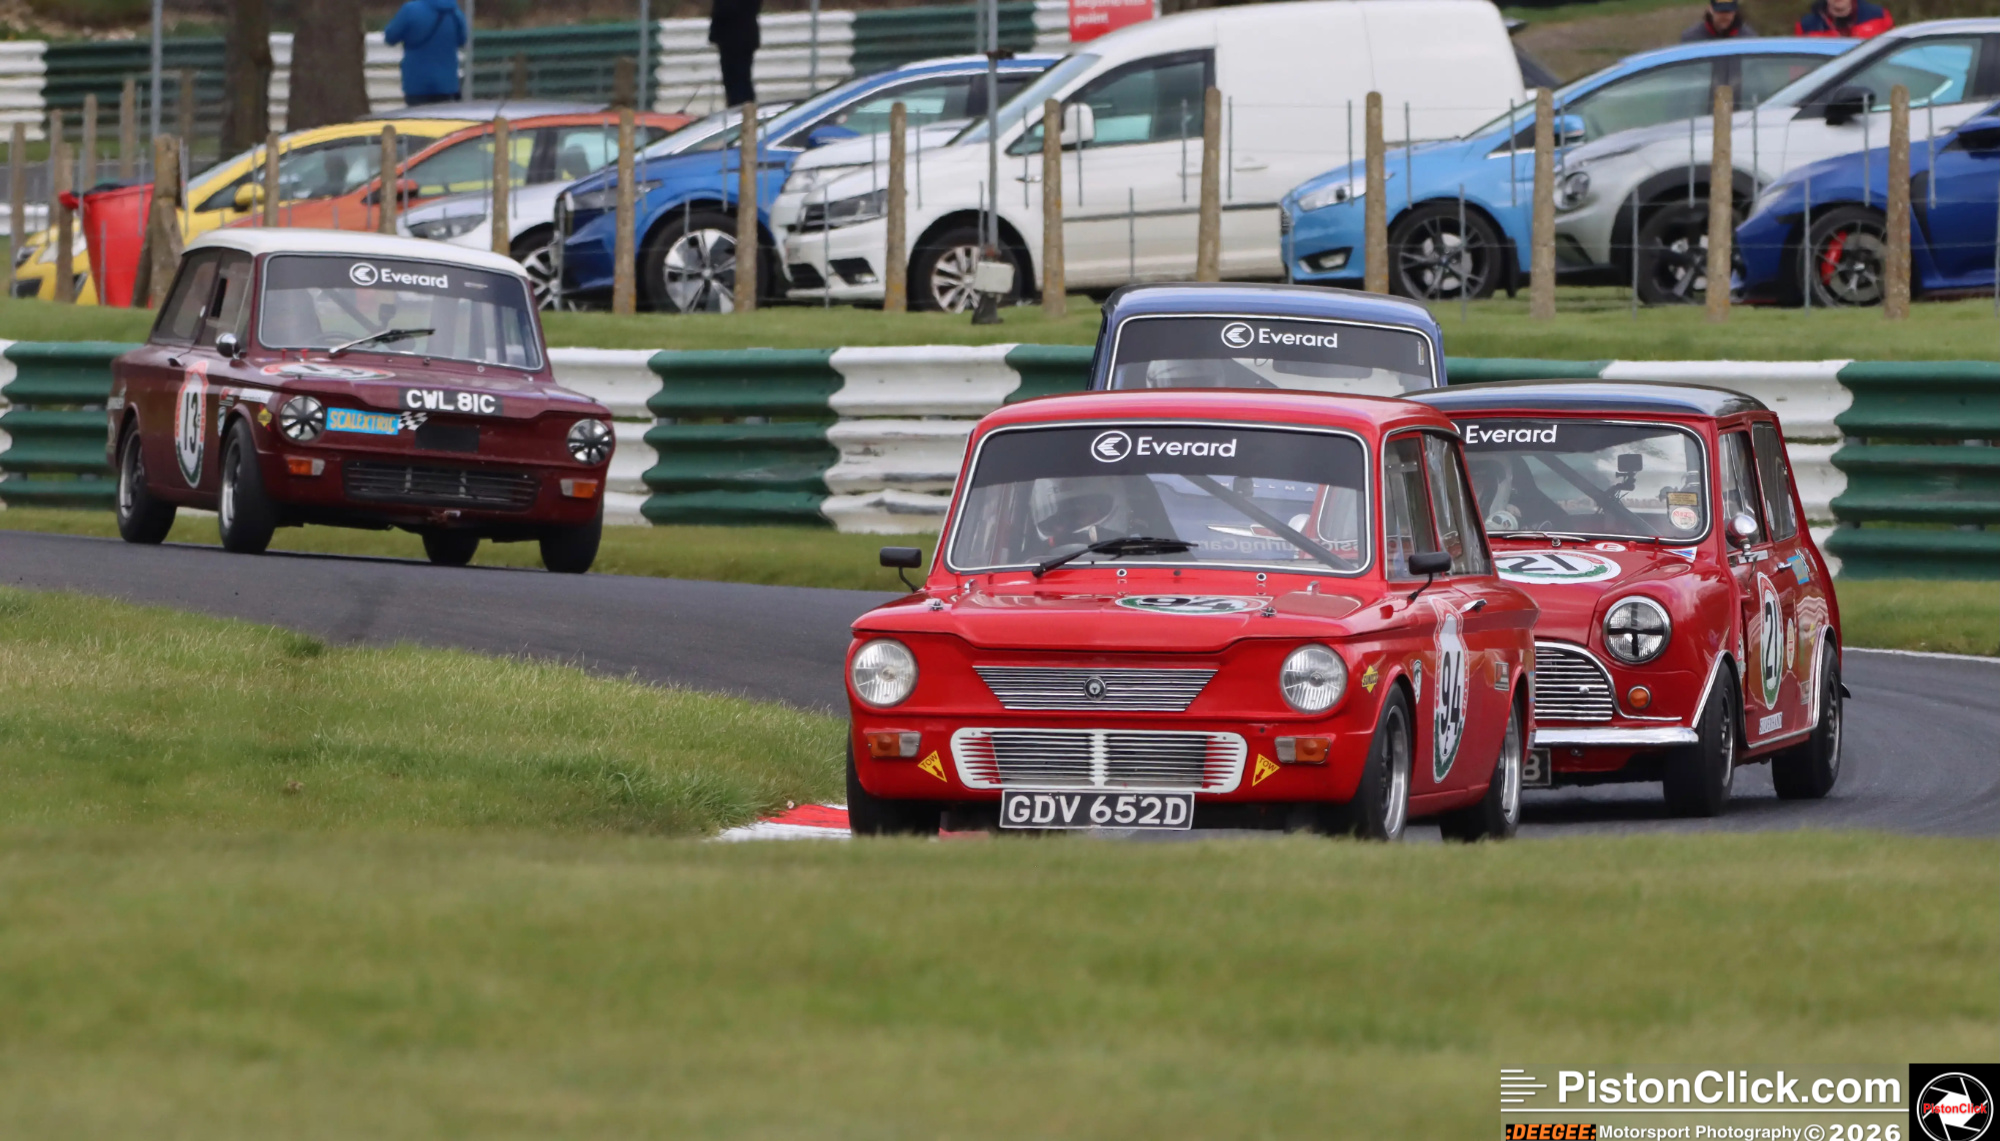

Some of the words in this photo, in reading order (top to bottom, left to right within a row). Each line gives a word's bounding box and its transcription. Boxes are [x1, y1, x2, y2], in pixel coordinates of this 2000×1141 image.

[380, 268, 448, 289] Everard
[1258, 328, 1338, 348] Everard
[406, 389, 454, 411] CWL
[457, 392, 496, 414] 81C
[184, 391, 199, 454] 13
[329, 410, 397, 433] SCALEXTRIC
[1465, 424, 1558, 444] Everard
[1136, 436, 1238, 457] Everard
[1495, 554, 1580, 572] 21
[1139, 596, 1235, 610] 94
[1765, 600, 1777, 681] 21
[1440, 650, 1461, 736] 94
[921, 753, 938, 769] TOW
[1259, 756, 1277, 772] TOW
[1008, 795, 1081, 823] GDV
[1089, 795, 1187, 825] 652D
